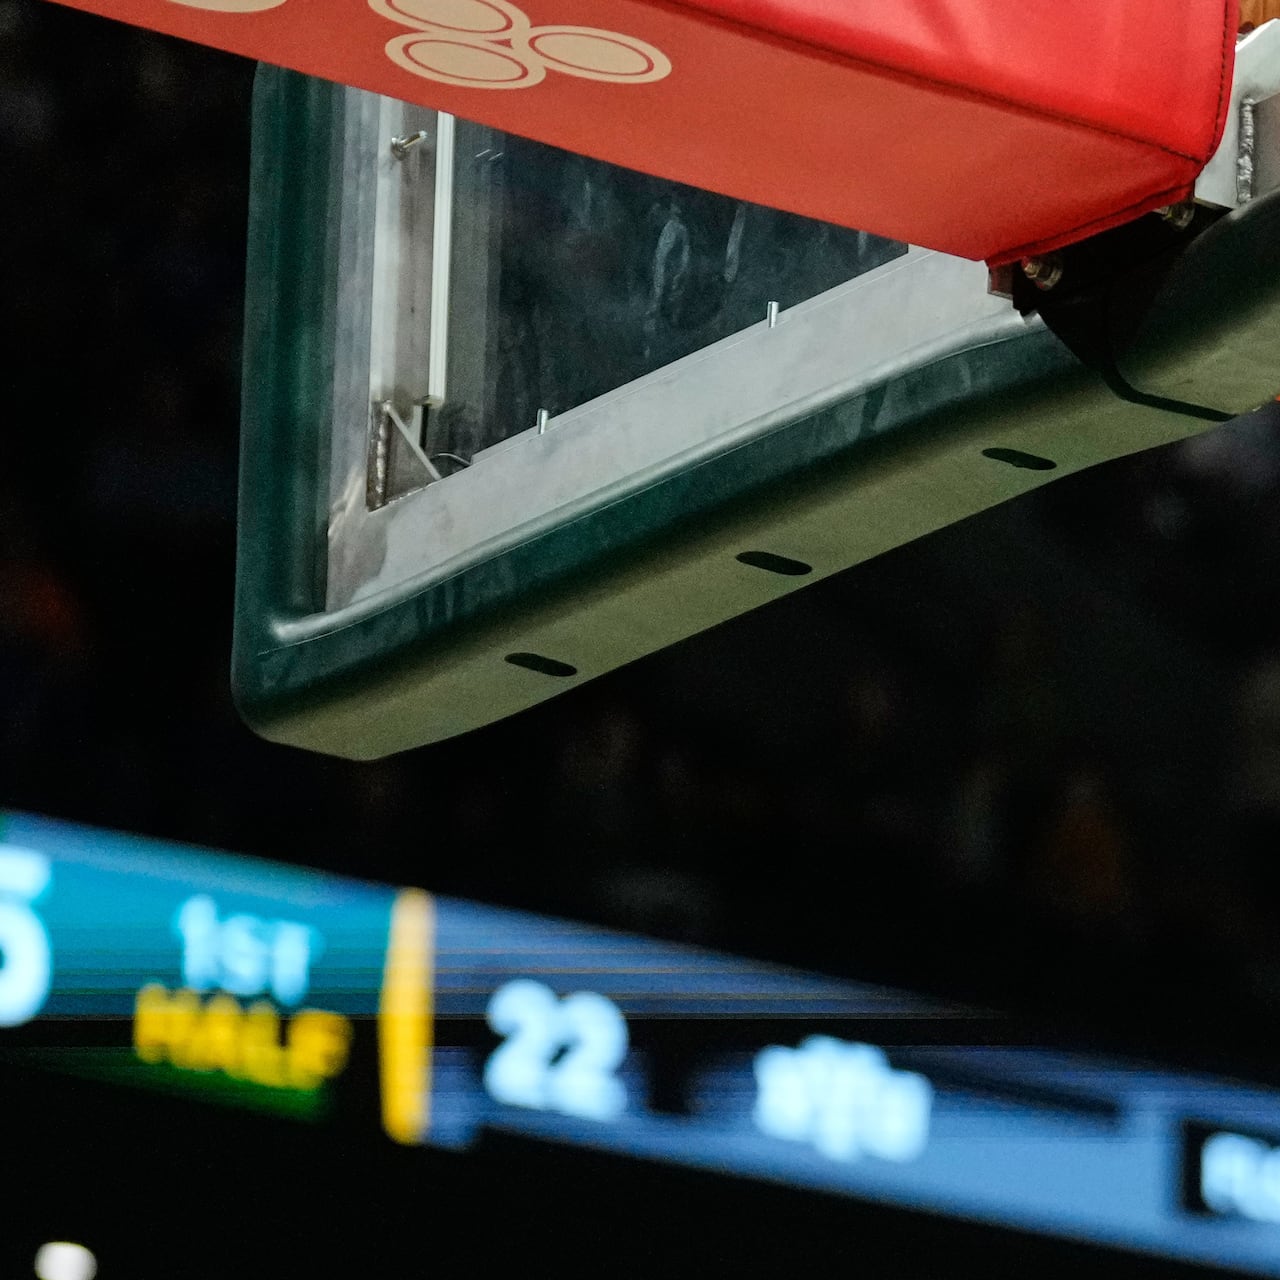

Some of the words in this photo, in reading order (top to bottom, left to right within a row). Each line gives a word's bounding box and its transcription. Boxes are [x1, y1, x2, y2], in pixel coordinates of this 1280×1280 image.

[173, 893, 322, 1005] 1ST
[133, 982, 351, 1090] HALF
[485, 979, 628, 1122] 22
